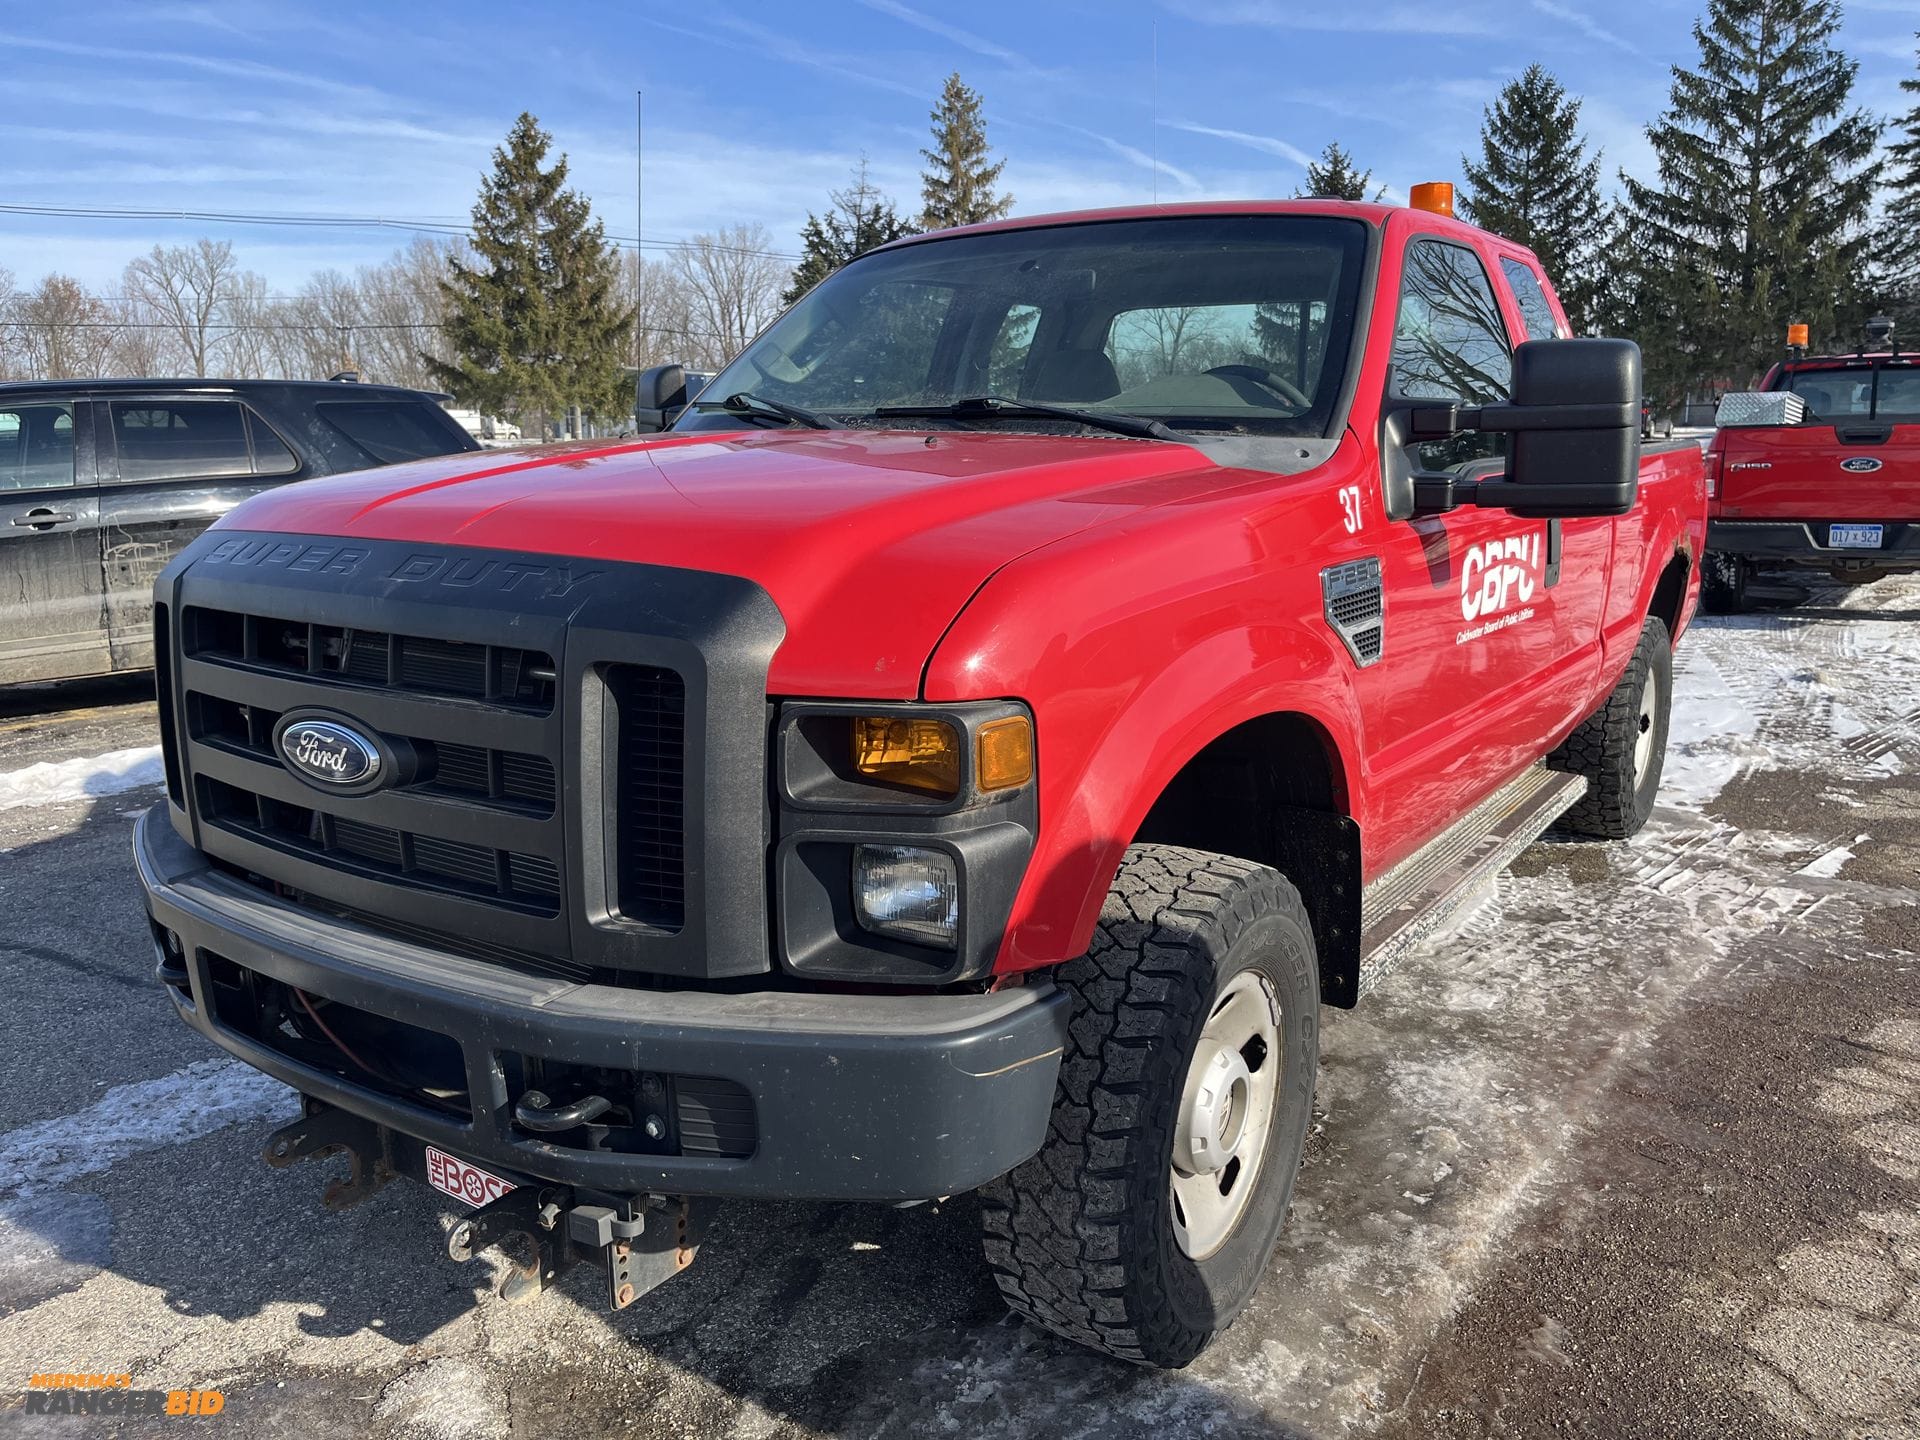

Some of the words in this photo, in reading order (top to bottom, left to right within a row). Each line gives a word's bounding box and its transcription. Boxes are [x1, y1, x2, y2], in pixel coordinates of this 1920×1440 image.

[1338, 485, 1364, 534] 37
[1832, 531, 1850, 543] 017
[1861, 531, 1880, 543] 923
[203, 537, 372, 577] SUPER
[388, 552, 607, 599] DUTY
[1456, 627, 1483, 645] Coldwater
[1484, 619, 1500, 635] Board
[1504, 612, 1518, 626] Public
[296, 729, 348, 773] Ford
[429, 1149, 444, 1184] THE
